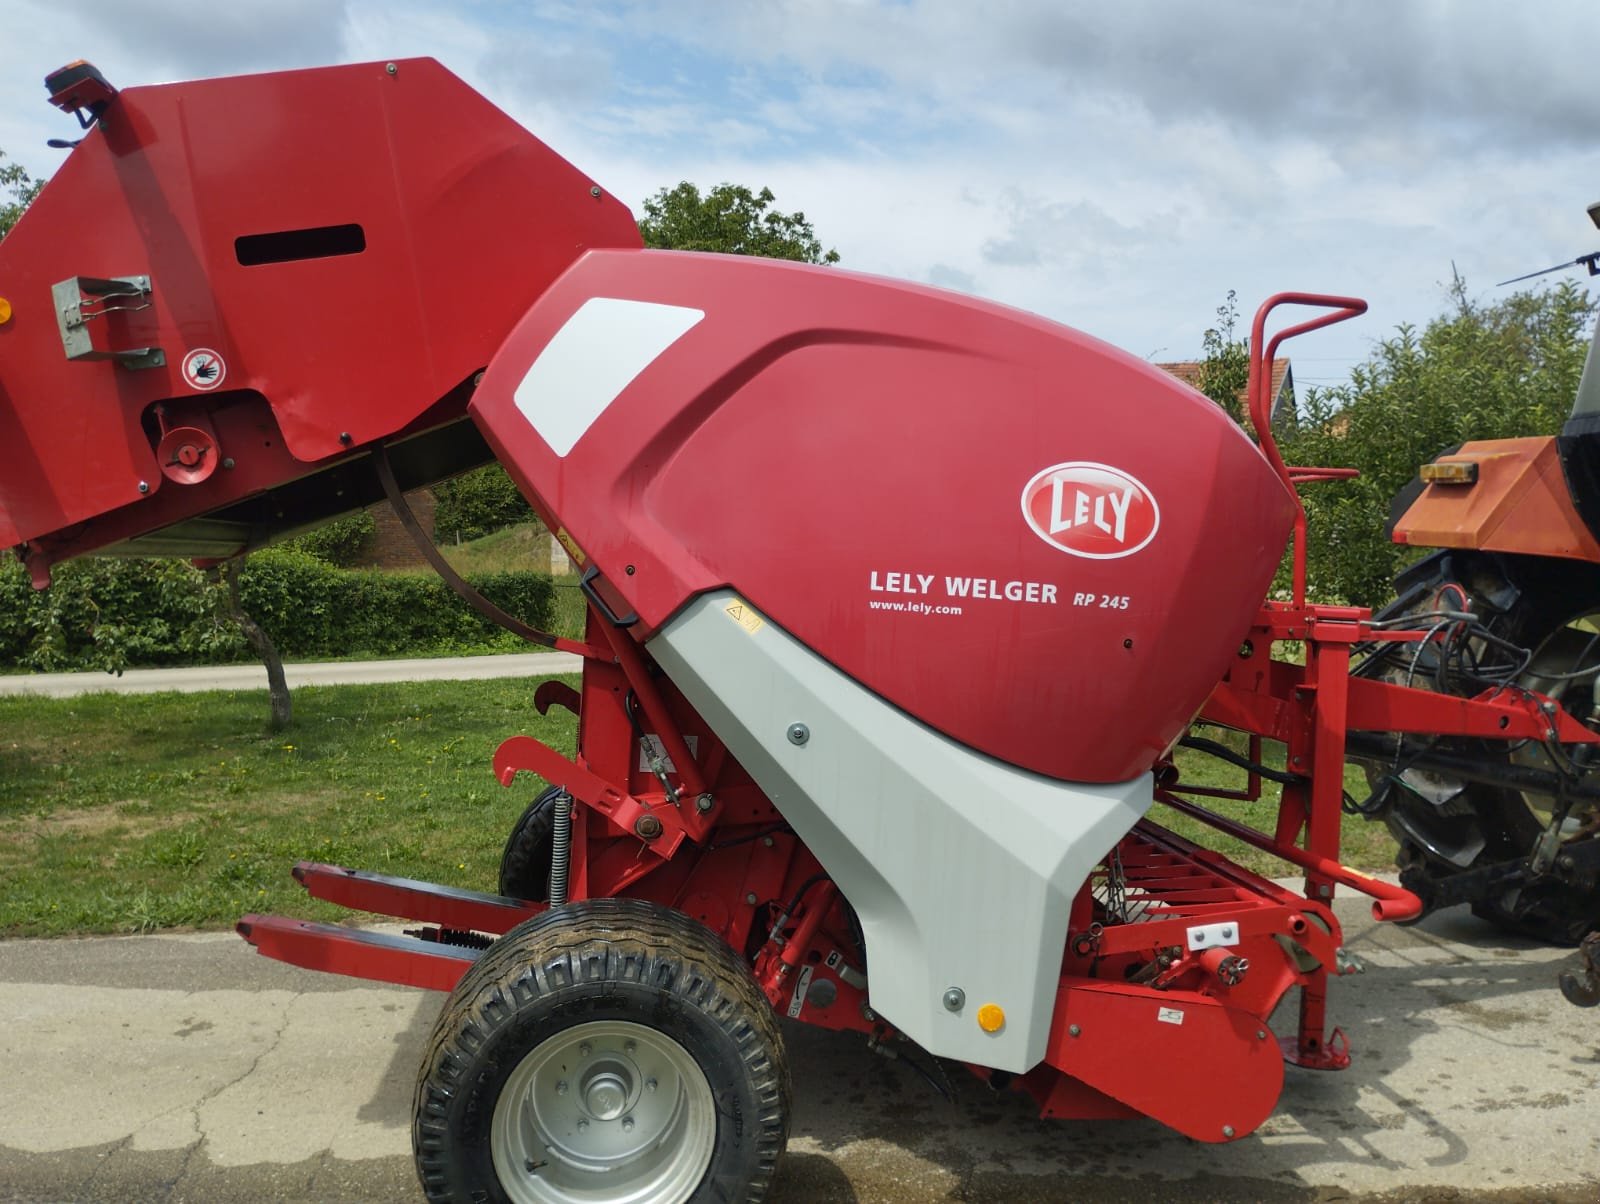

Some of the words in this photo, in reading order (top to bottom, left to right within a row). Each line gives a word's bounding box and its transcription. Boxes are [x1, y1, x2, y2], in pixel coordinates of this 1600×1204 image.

[1050, 476, 1133, 543] LELY
[869, 601, 962, 615] www.lely.com
[870, 571, 935, 594] LELY
[945, 577, 1058, 604] WELGER
[1073, 593, 1096, 607] RP
[1099, 595, 1130, 609] 245
